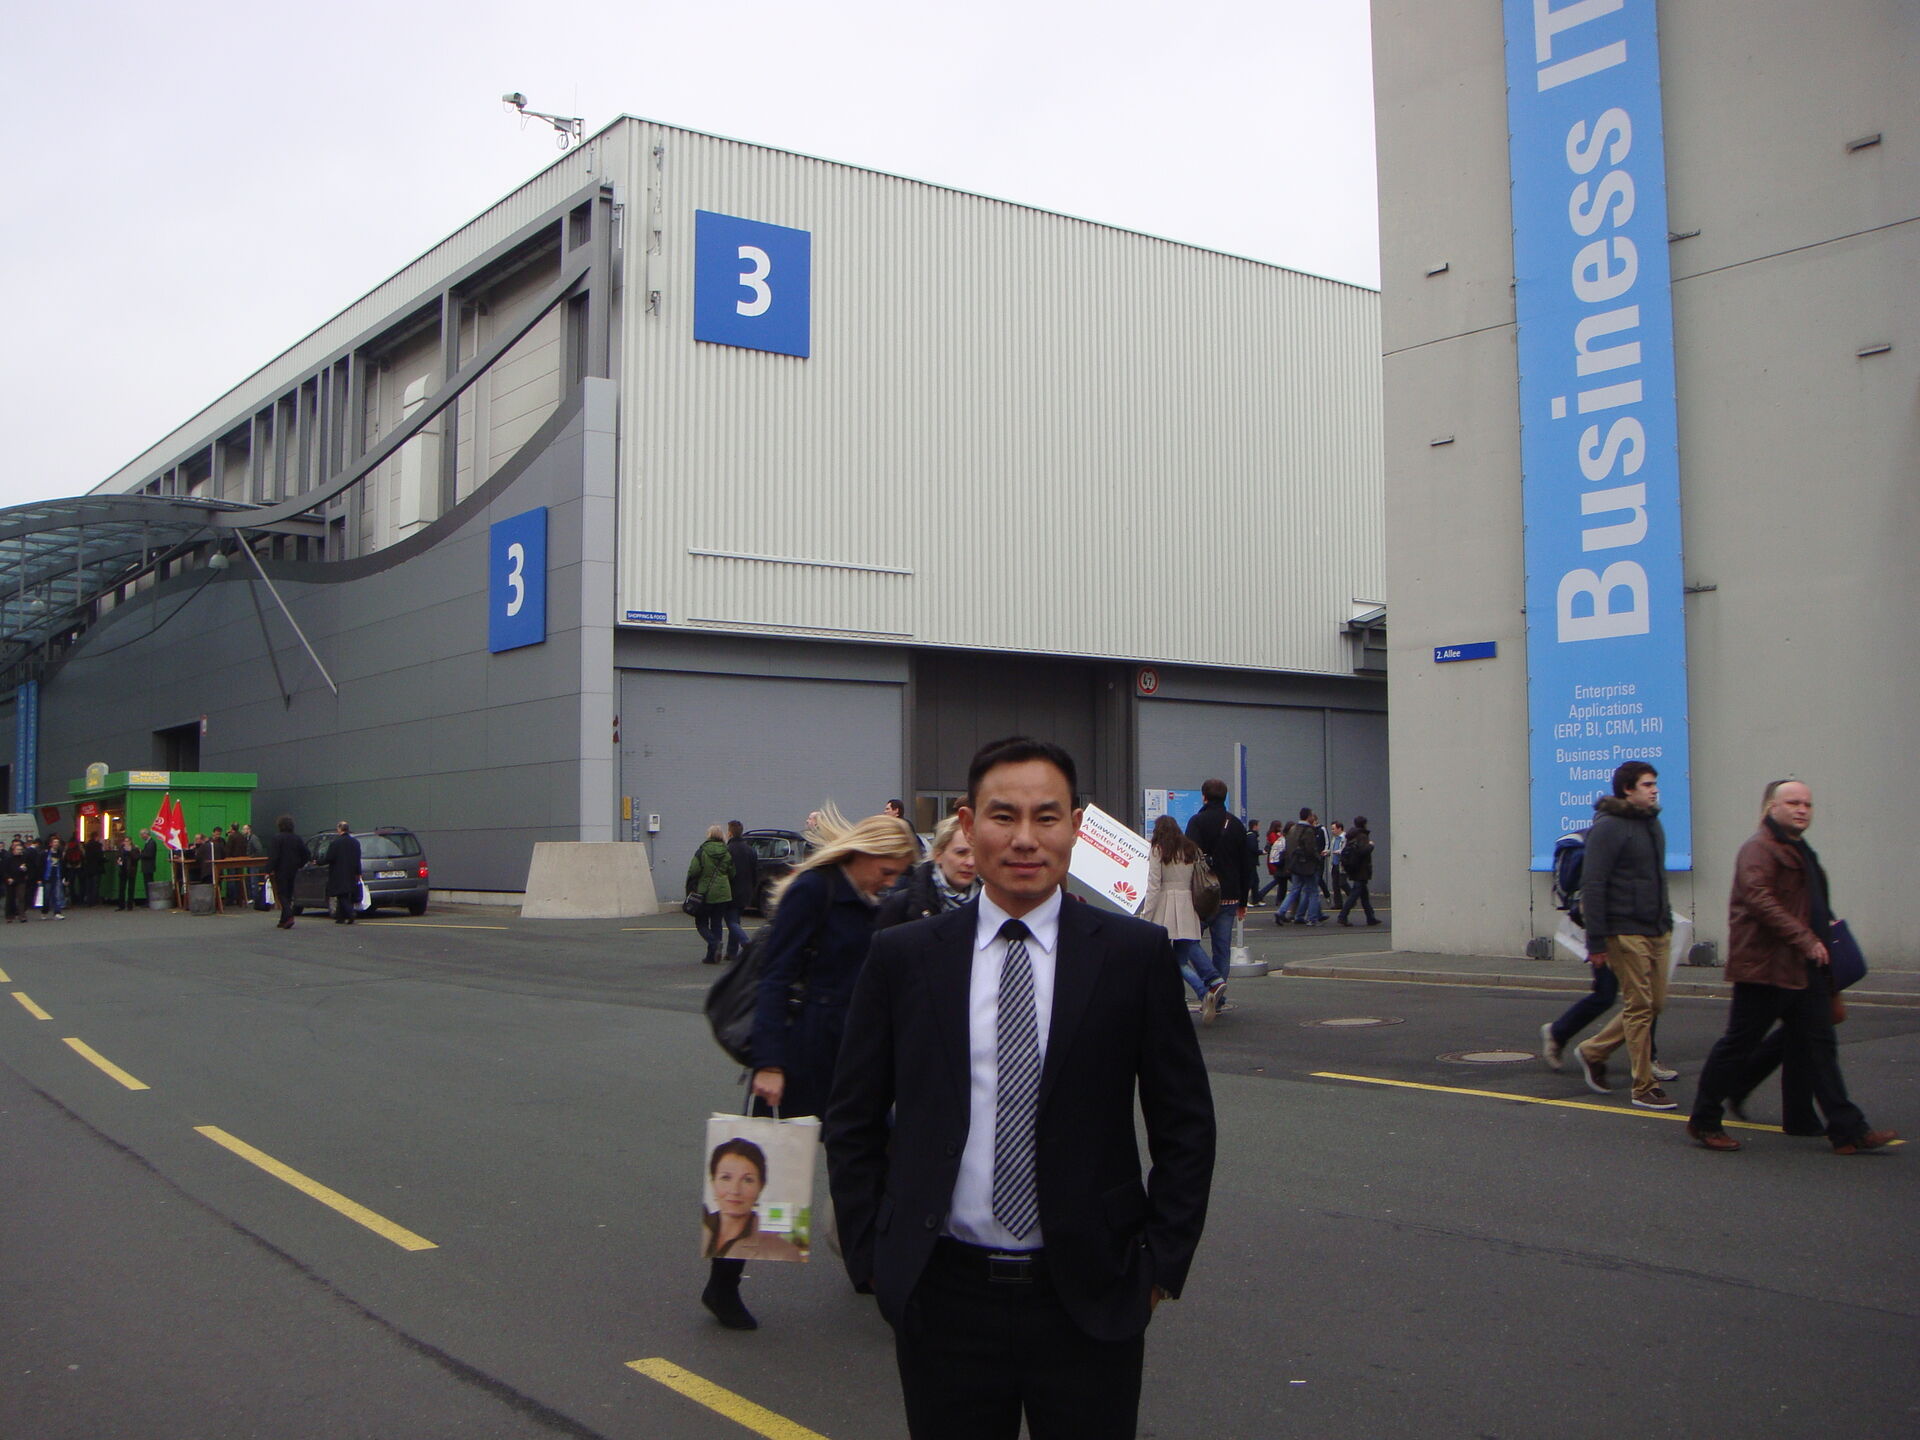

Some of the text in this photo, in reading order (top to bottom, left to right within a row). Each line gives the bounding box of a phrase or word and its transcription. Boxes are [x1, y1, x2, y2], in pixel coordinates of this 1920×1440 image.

[736, 246, 772, 317] 3
[1532, 0, 1650, 643] Business IT
[505, 543, 525, 617] 3
[1436, 649, 1461, 659] 2. Allee
[1575, 681, 1636, 700] Enterprise
[1568, 701, 1643, 720] Applications
[1554, 717, 1663, 740] (ERP, BI, CRM, HR)
[1556, 745, 1663, 763] Business Process
[1560, 790, 1592, 806] Cloud
[1086, 816, 1117, 840] Huawei
[1090, 828, 1115, 847] Better
[1116, 844, 1134, 861] Way
[1108, 888, 1133, 909] HUAWEI
